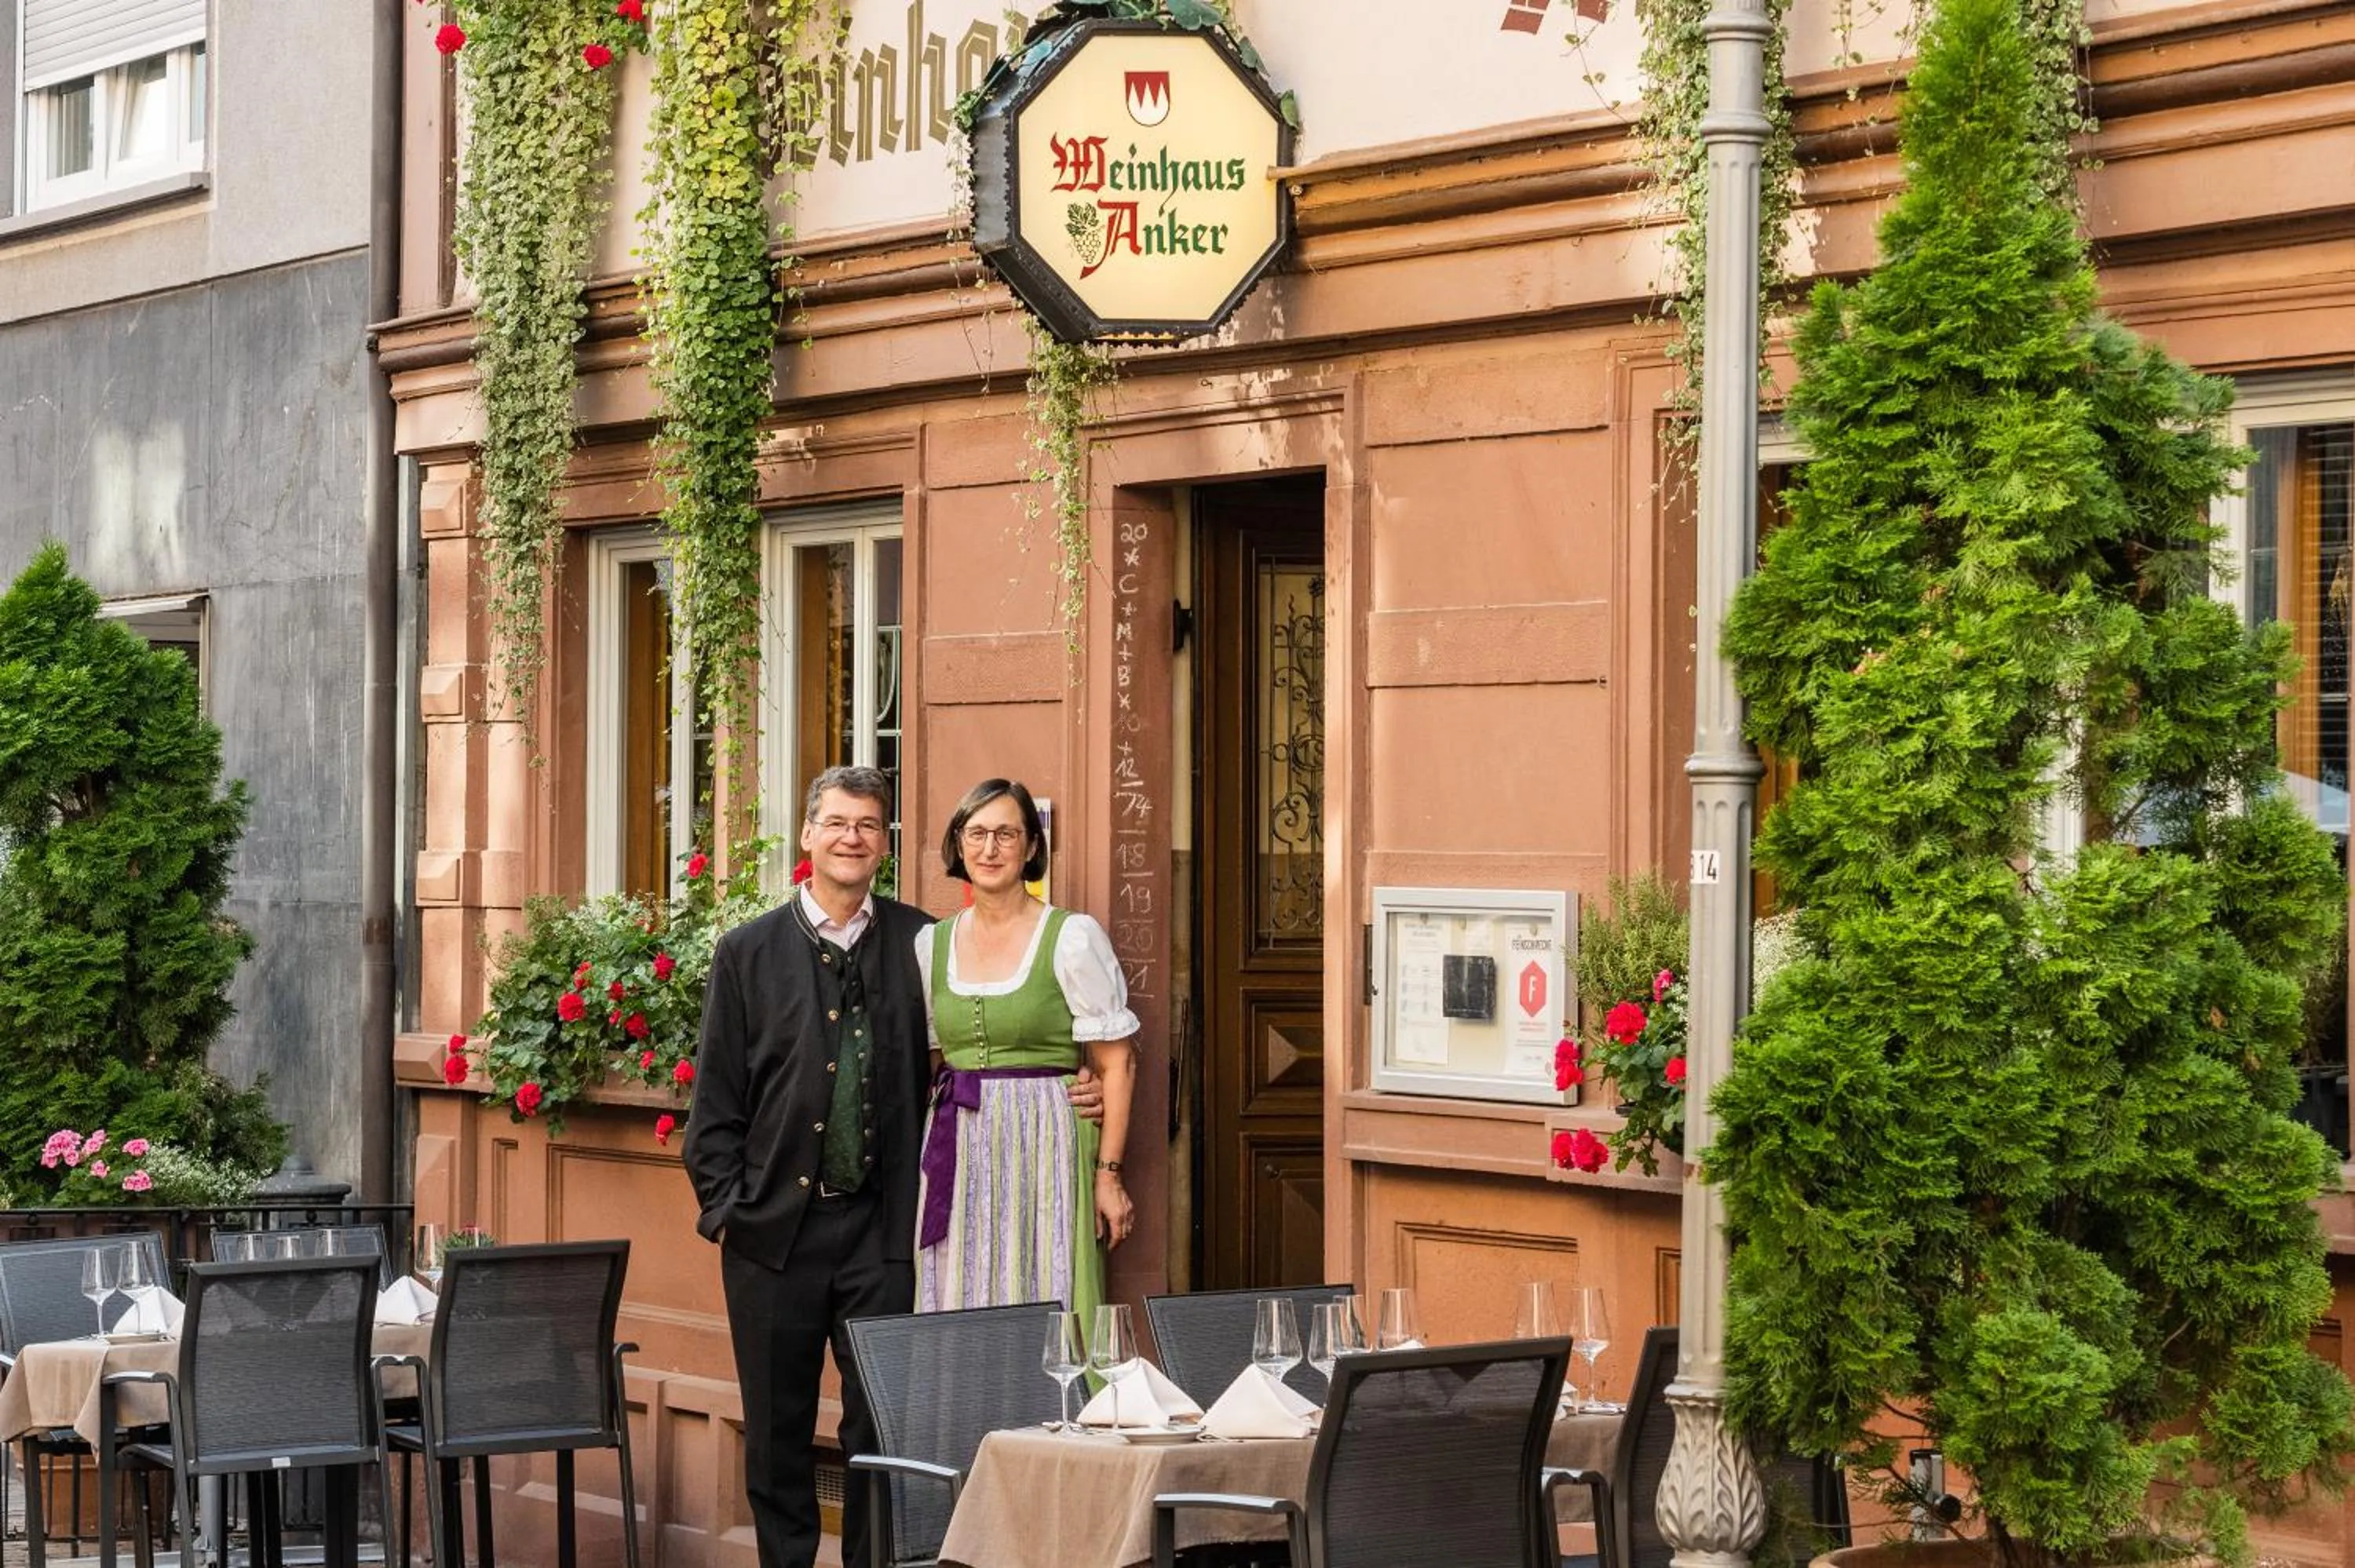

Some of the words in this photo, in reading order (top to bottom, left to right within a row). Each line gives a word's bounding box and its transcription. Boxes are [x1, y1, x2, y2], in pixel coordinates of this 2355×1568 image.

[1050, 132, 1246, 217] Weinhaus
[1079, 199, 1229, 280] Anker
[1119, 573, 1139, 594] C
